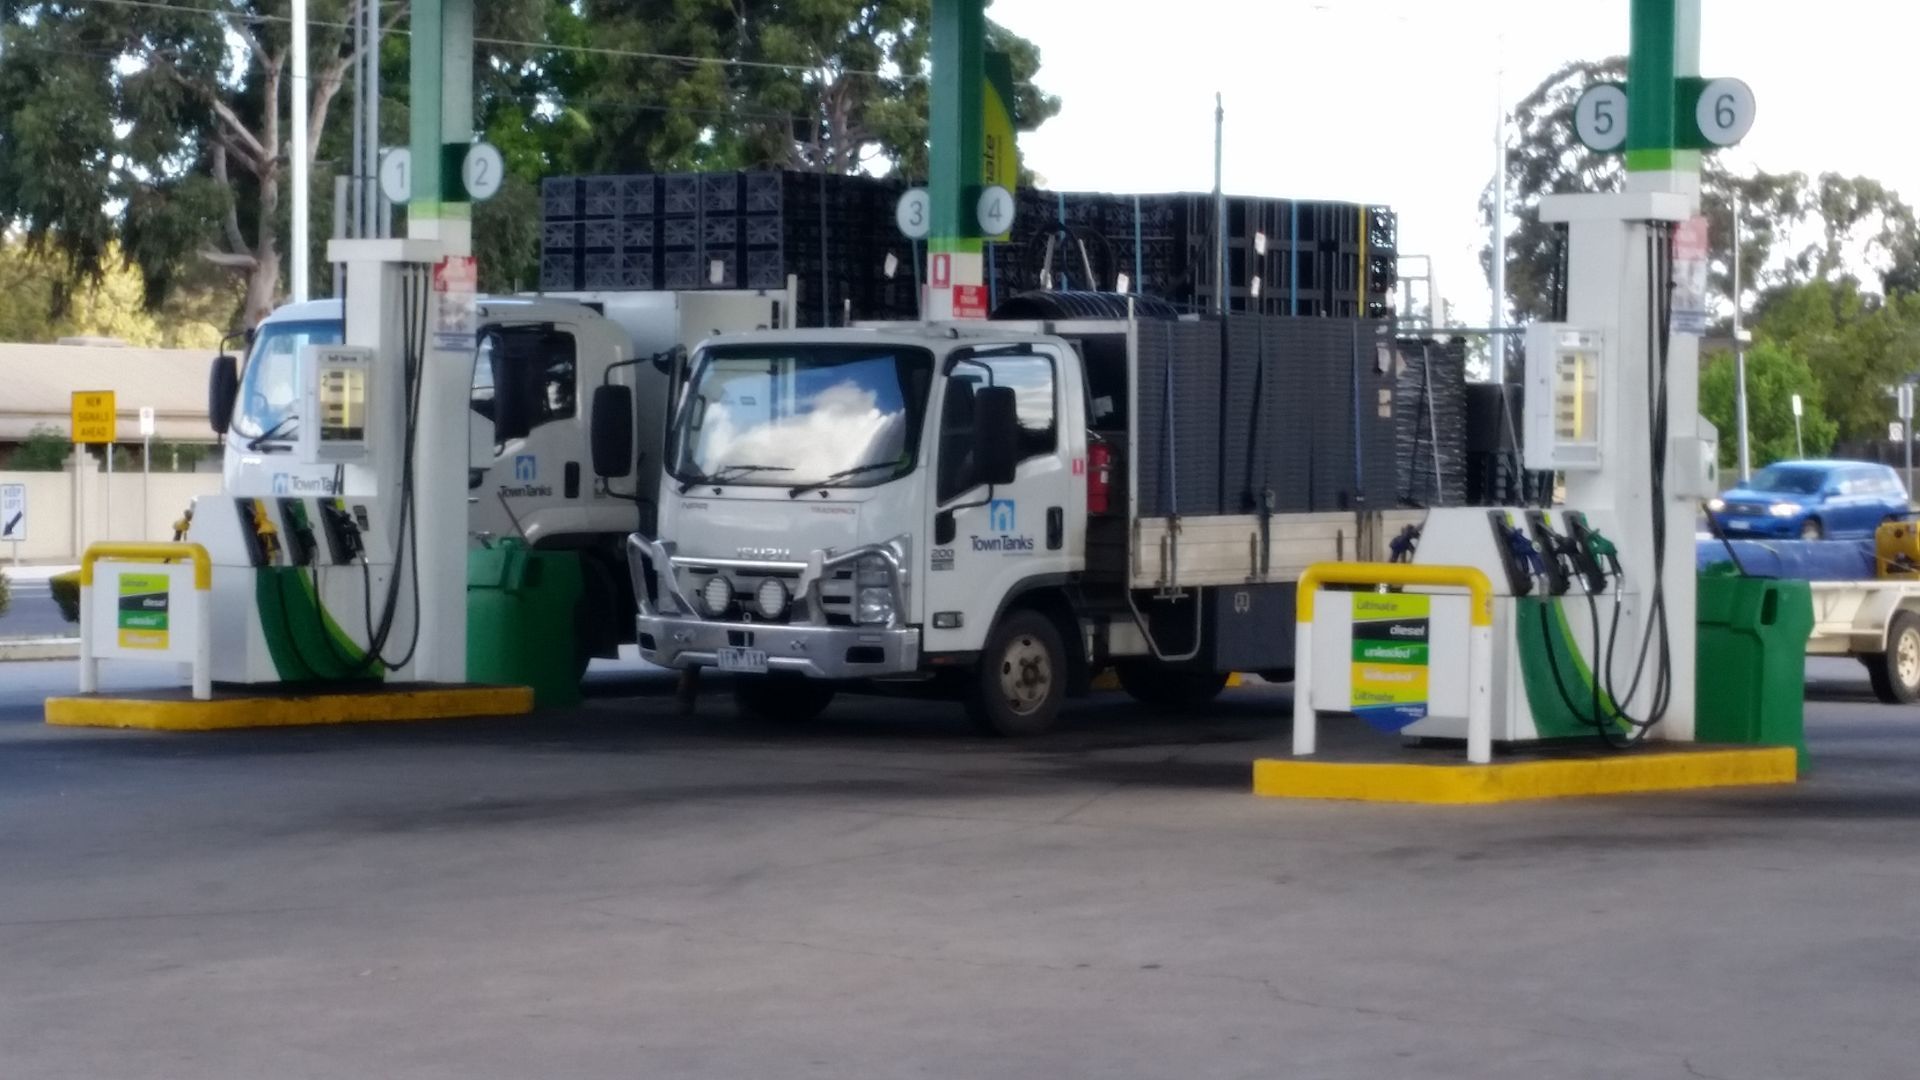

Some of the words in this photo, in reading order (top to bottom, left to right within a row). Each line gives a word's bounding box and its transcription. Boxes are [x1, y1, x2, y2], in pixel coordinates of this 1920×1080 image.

[1593, 100, 1614, 135] 5
[1714, 93, 1736, 129] 6
[396, 161, 405, 189] 1
[474, 157, 489, 186] 2
[909, 200, 923, 226] 3
[987, 197, 1003, 222] 4
[970, 535, 1034, 551] TownTanks
[1390, 625, 1425, 636] diesel
